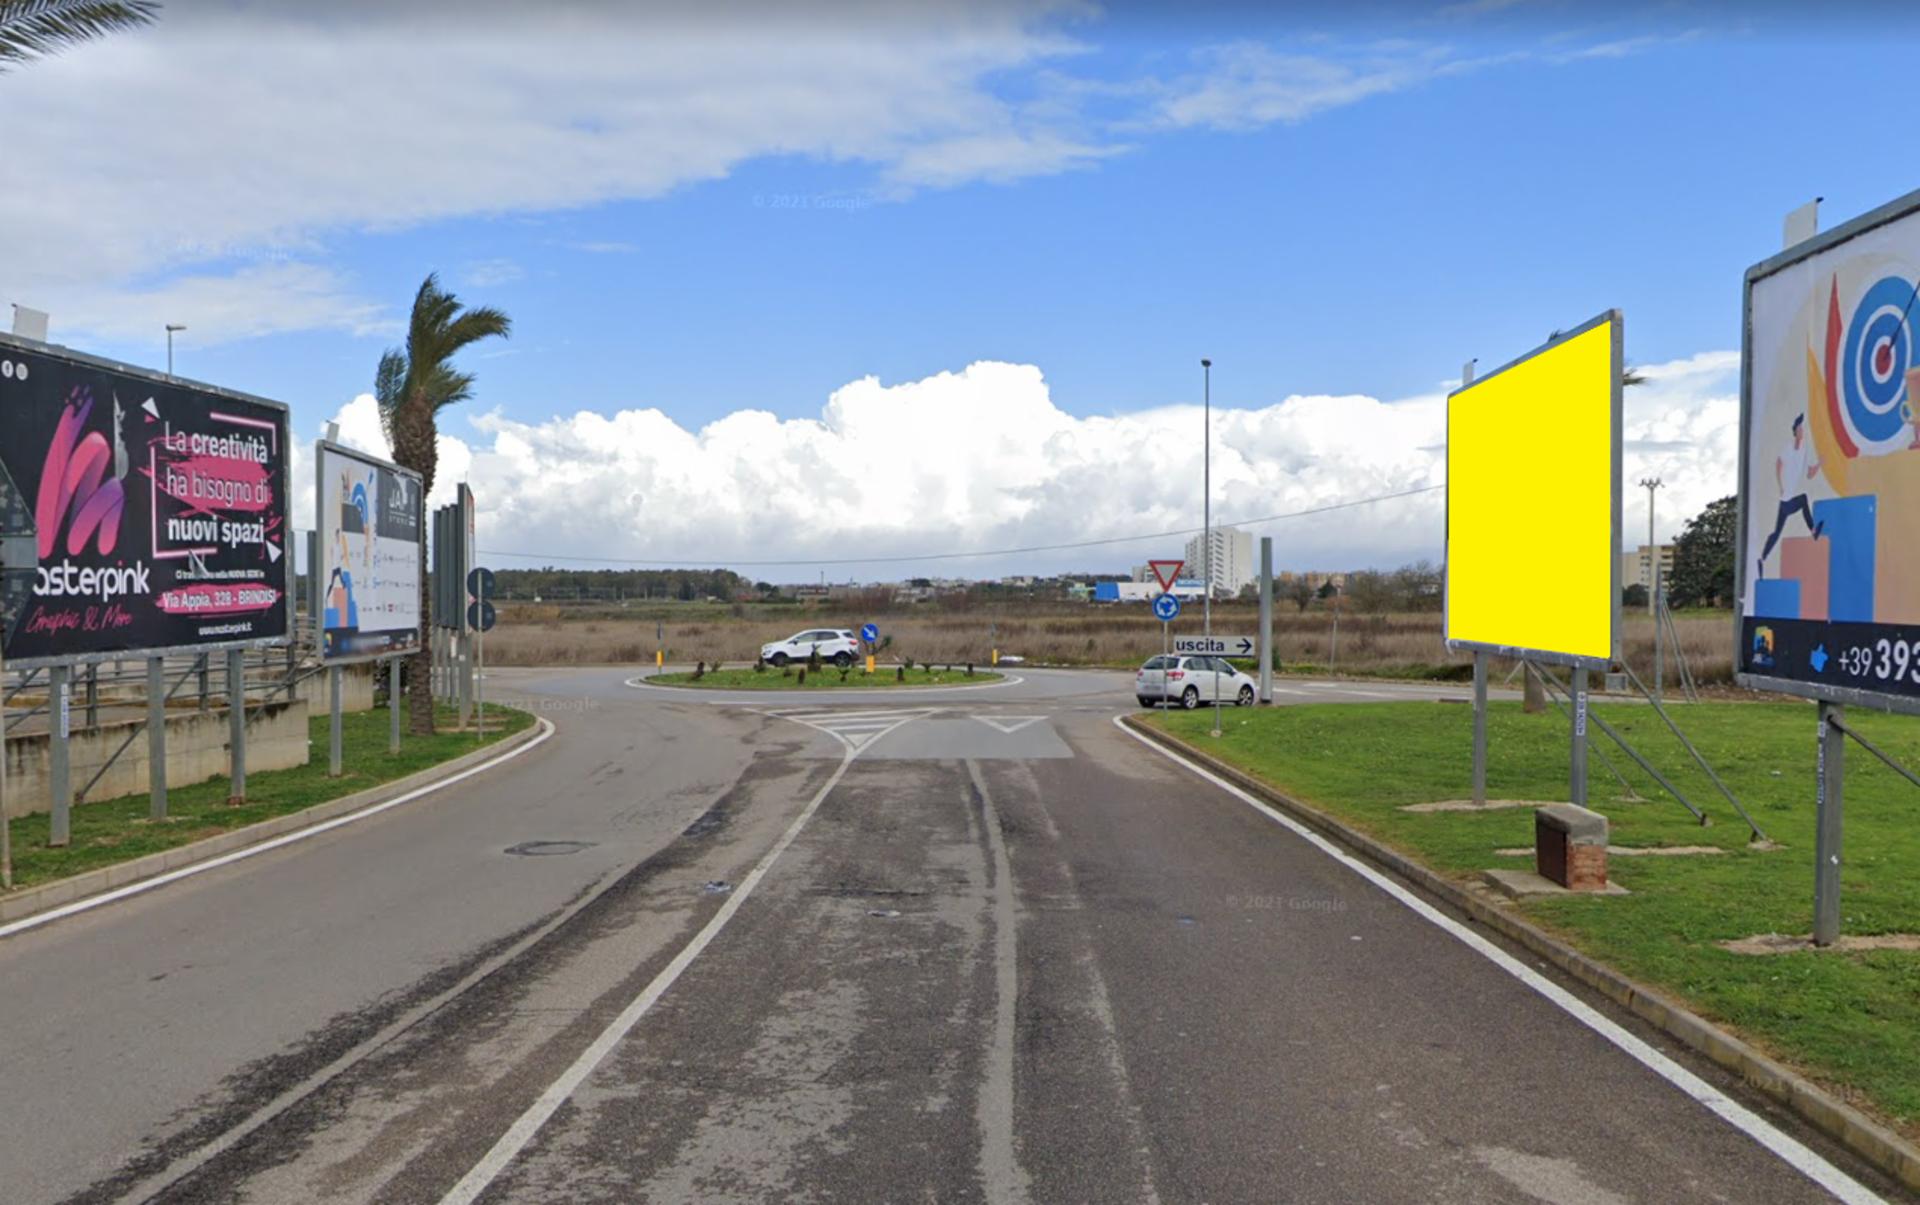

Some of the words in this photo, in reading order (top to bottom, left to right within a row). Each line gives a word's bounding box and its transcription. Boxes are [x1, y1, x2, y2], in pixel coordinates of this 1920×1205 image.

[165, 421, 188, 452] La
[191, 432, 269, 464] creatività
[166, 466, 189, 497] ha
[192, 470, 252, 508] bisogno
[255, 478, 269, 504] di
[168, 514, 218, 542] nuovi
[221, 517, 266, 549] spazi
[162, 591, 180, 608] Via
[238, 589, 277, 606] BRINDISI
[1175, 637, 1225, 652] uscita
[1838, 646, 1873, 677] +39
